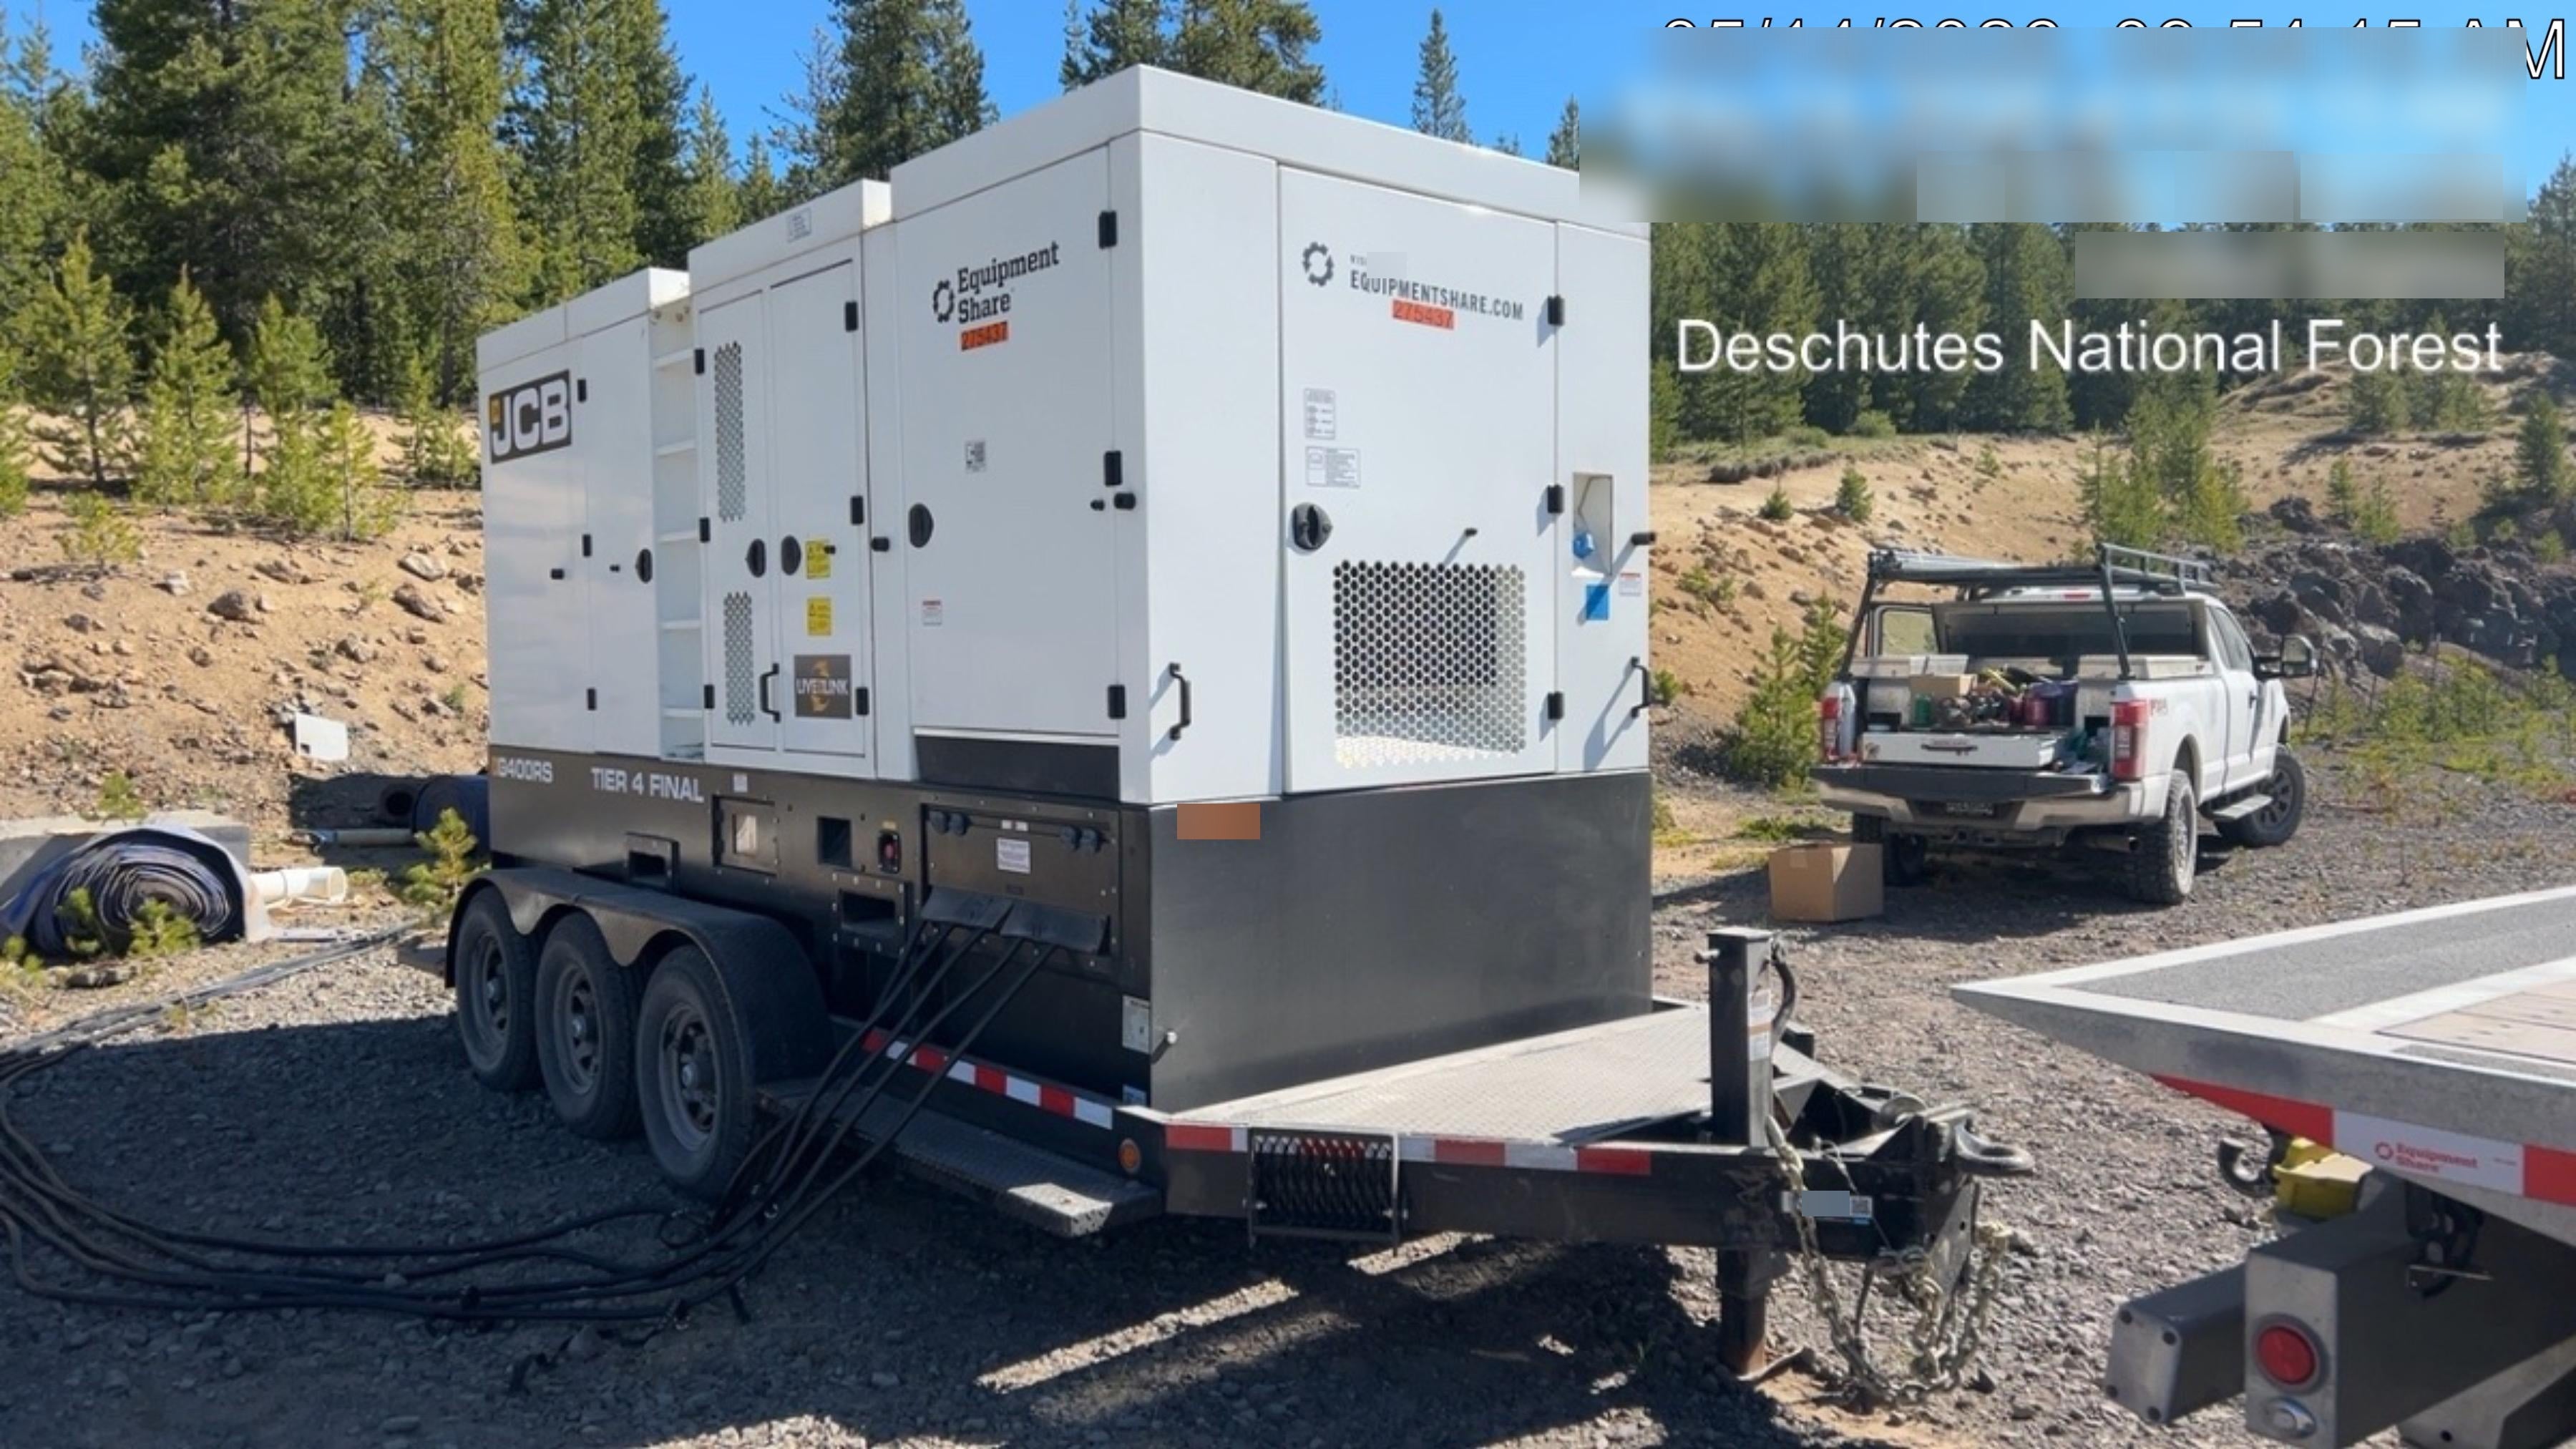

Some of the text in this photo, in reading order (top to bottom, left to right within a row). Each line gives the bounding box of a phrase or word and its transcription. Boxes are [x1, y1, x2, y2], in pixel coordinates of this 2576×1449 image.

[957, 240, 1060, 294] Equipment
[957, 292, 1011, 323] Share
[1350, 270, 1523, 320] EQUIPMENTSHARE.COM
[492, 378, 570, 457] JCB
[590, 767, 705, 804] TIER 4 FINAL
